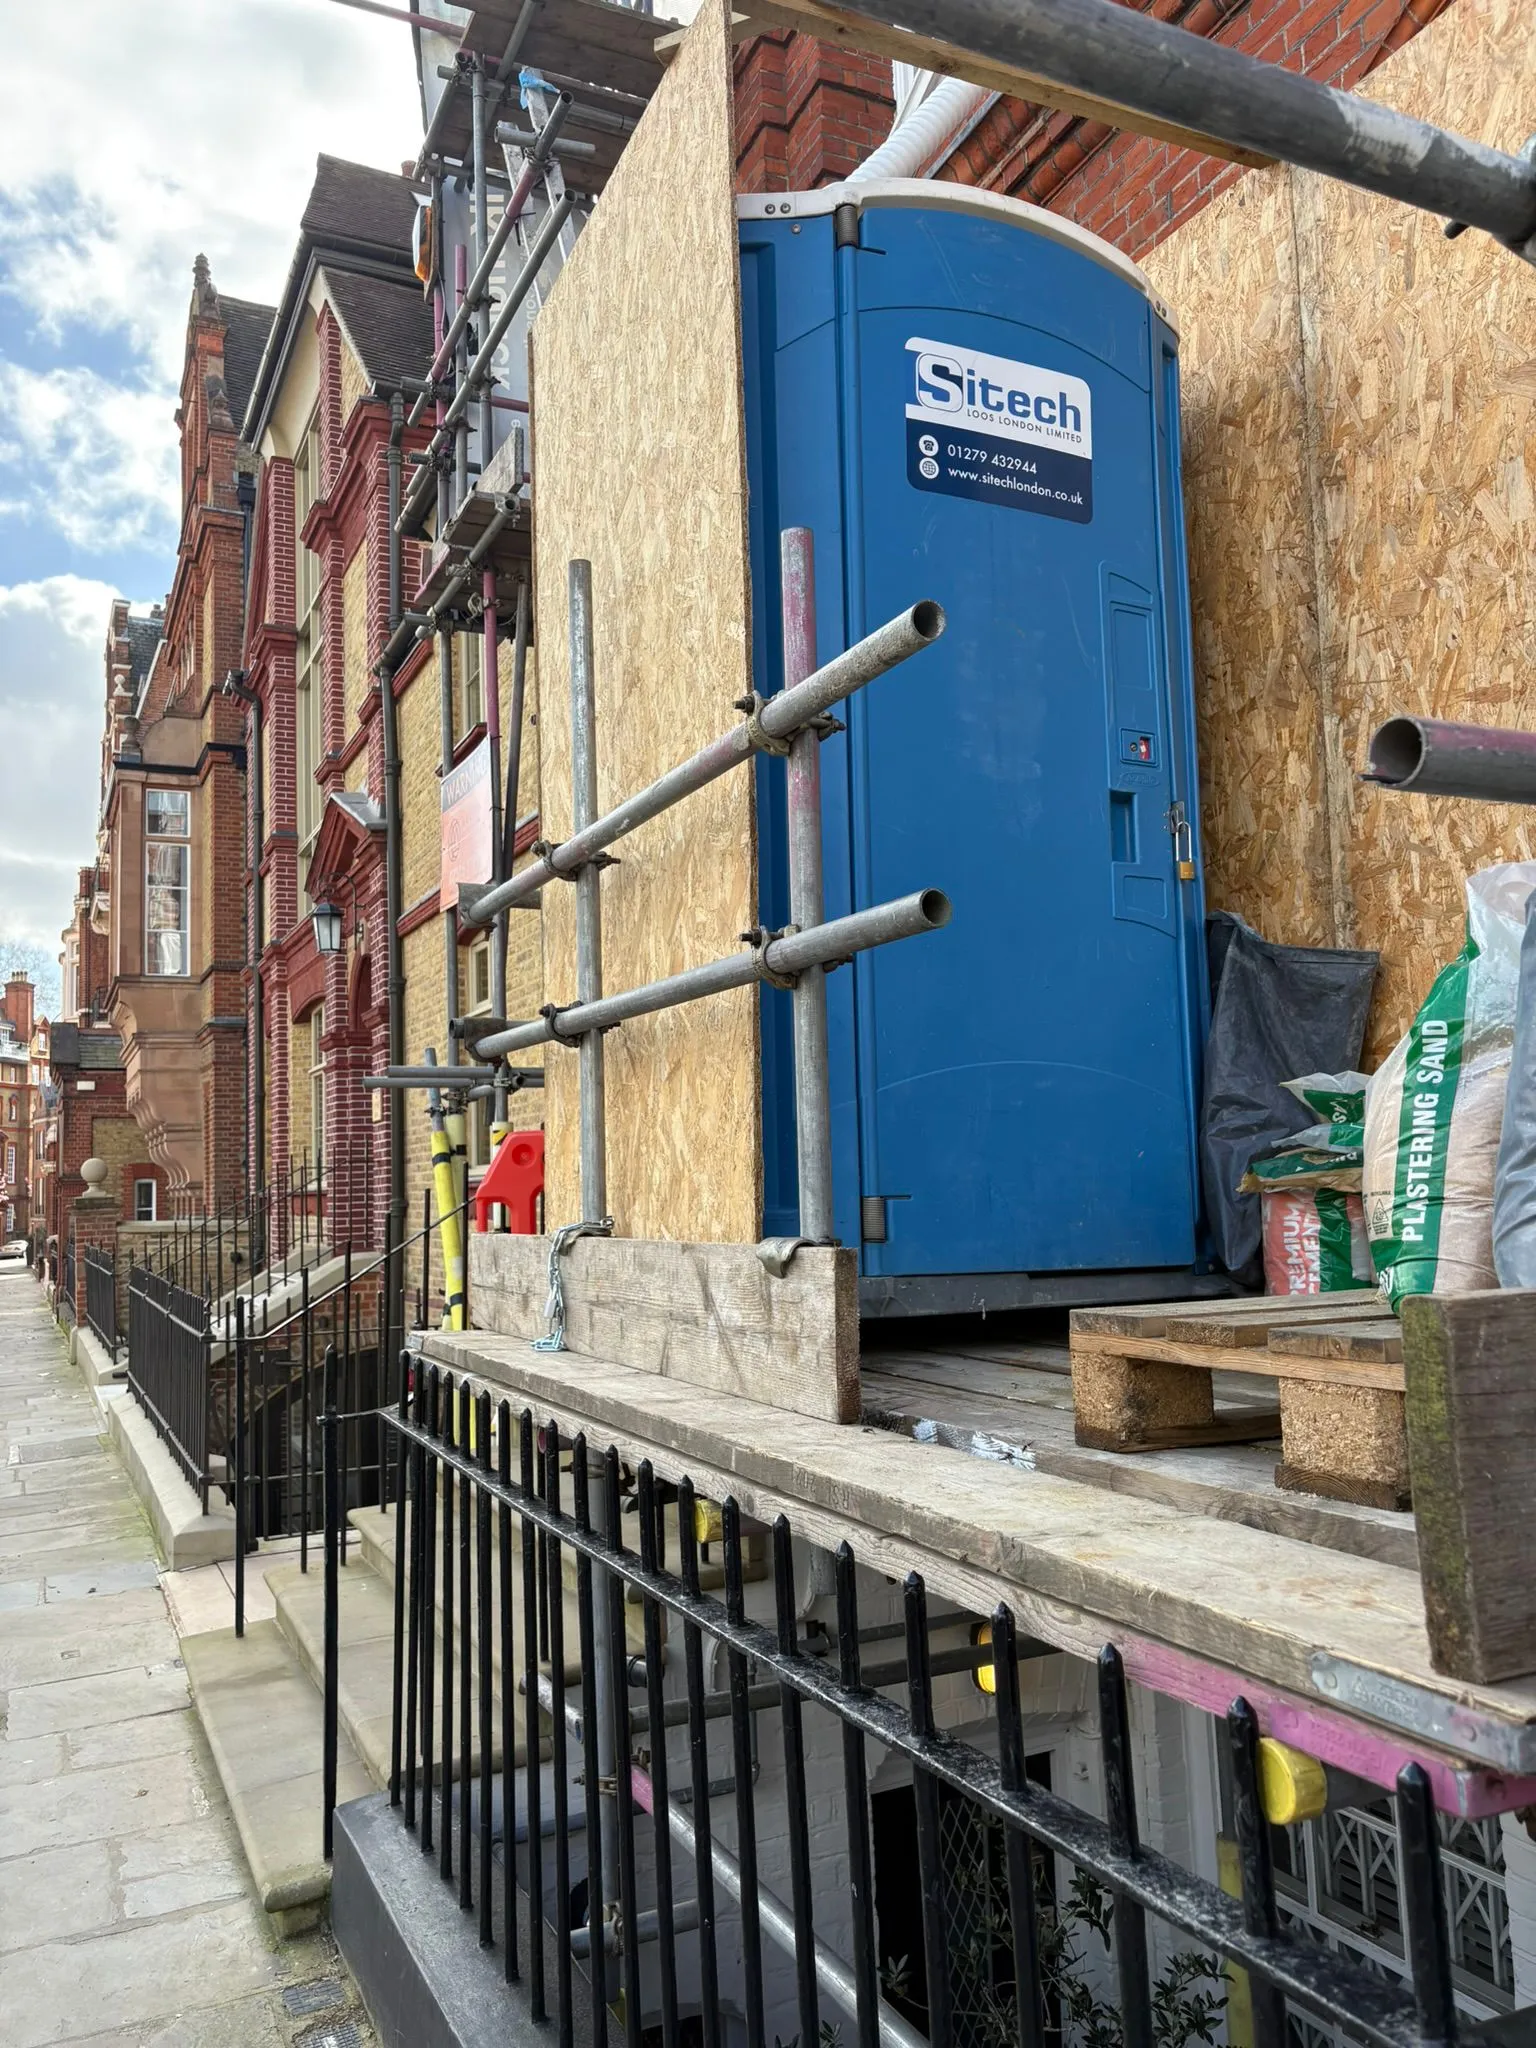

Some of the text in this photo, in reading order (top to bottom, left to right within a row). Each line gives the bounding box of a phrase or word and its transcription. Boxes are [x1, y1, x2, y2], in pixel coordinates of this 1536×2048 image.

[917, 354, 1082, 432] Sitech
[967, 408, 1083, 444] LOOS LONDON LIMITED
[947, 444, 1038, 475] 01279 432944
[947, 467, 1084, 505] www.sitechlondon.co.uk
[446, 753, 488, 805] WARNING
[1401, 1019, 1449, 1242] PLASTERING SAND
